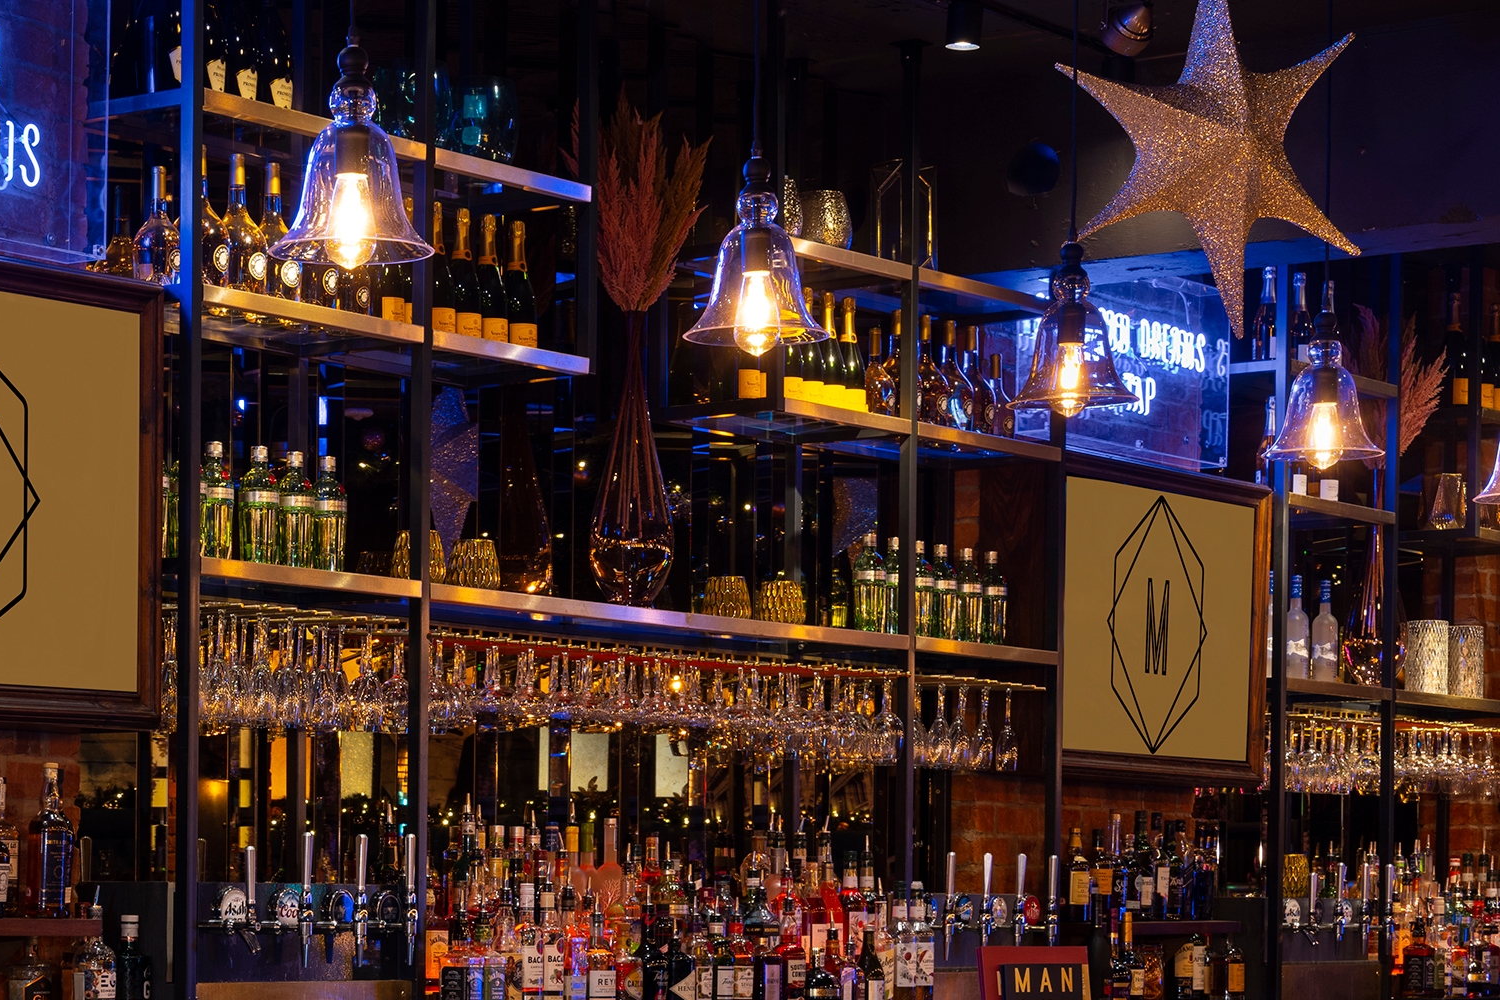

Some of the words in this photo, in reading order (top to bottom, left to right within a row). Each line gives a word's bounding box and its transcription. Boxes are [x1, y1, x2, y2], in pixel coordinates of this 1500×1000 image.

[1145, 577, 1170, 676] M
[279, 905, 299, 917] Coo
[1014, 967, 1074, 993] MAN
